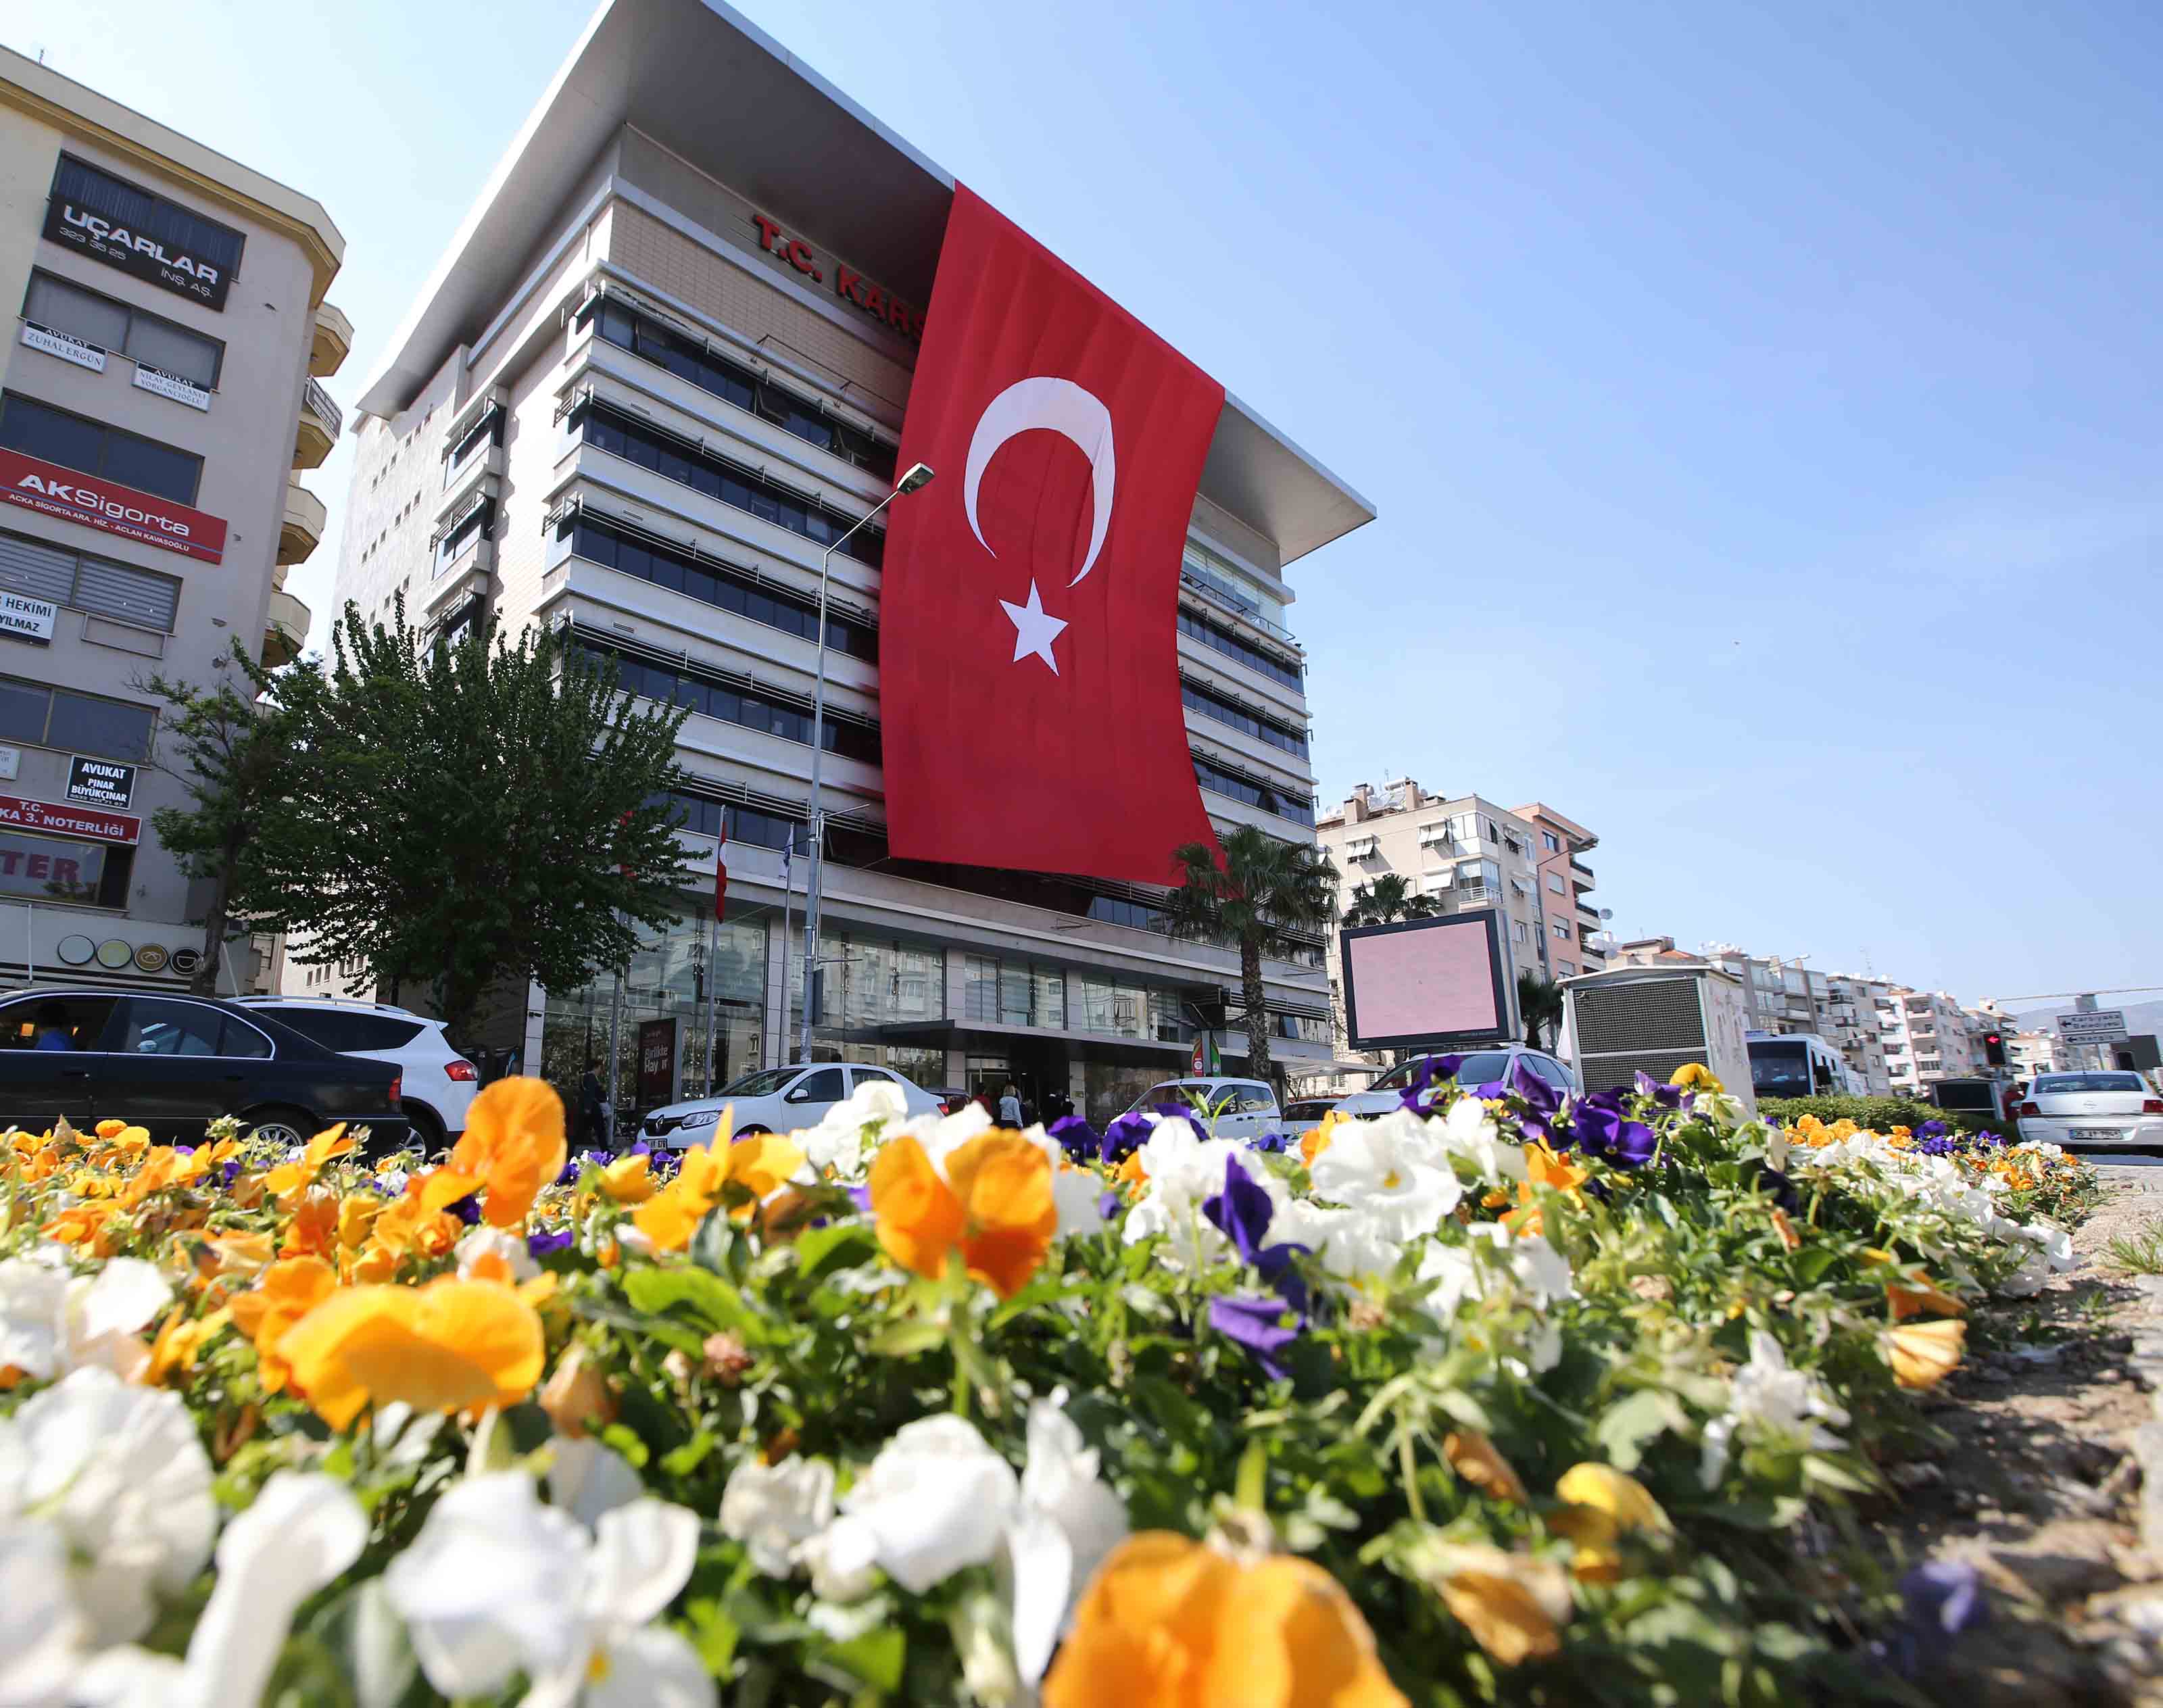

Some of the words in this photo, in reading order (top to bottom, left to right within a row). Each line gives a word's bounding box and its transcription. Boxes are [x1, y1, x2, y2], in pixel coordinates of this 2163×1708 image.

[59, 226, 87, 243] 323
[108, 248, 127, 261] 25
[64, 205, 218, 285] UÇARLAR
[752, 214, 823, 283] T.C.
[27, 331, 66, 352] ZUHAL
[45, 328, 90, 349] AVUKAT
[153, 368, 195, 387] AVUKAT
[9, 493, 33, 505] ACKA
[34, 501, 72, 516] SİGORTA
[17, 474, 190, 537] AKSigorta
[5, 597, 52, 617] HEKİMİ
[82, 762, 126, 779] AVUKAT
[71, 784, 127, 802] BÜYÜKÇINAR
[87, 778, 115, 790] PINAR
[19, 800, 45, 814] T.C.
[25, 812, 39, 823] 3.
[43, 815, 124, 837] NOTERLİĞİ
